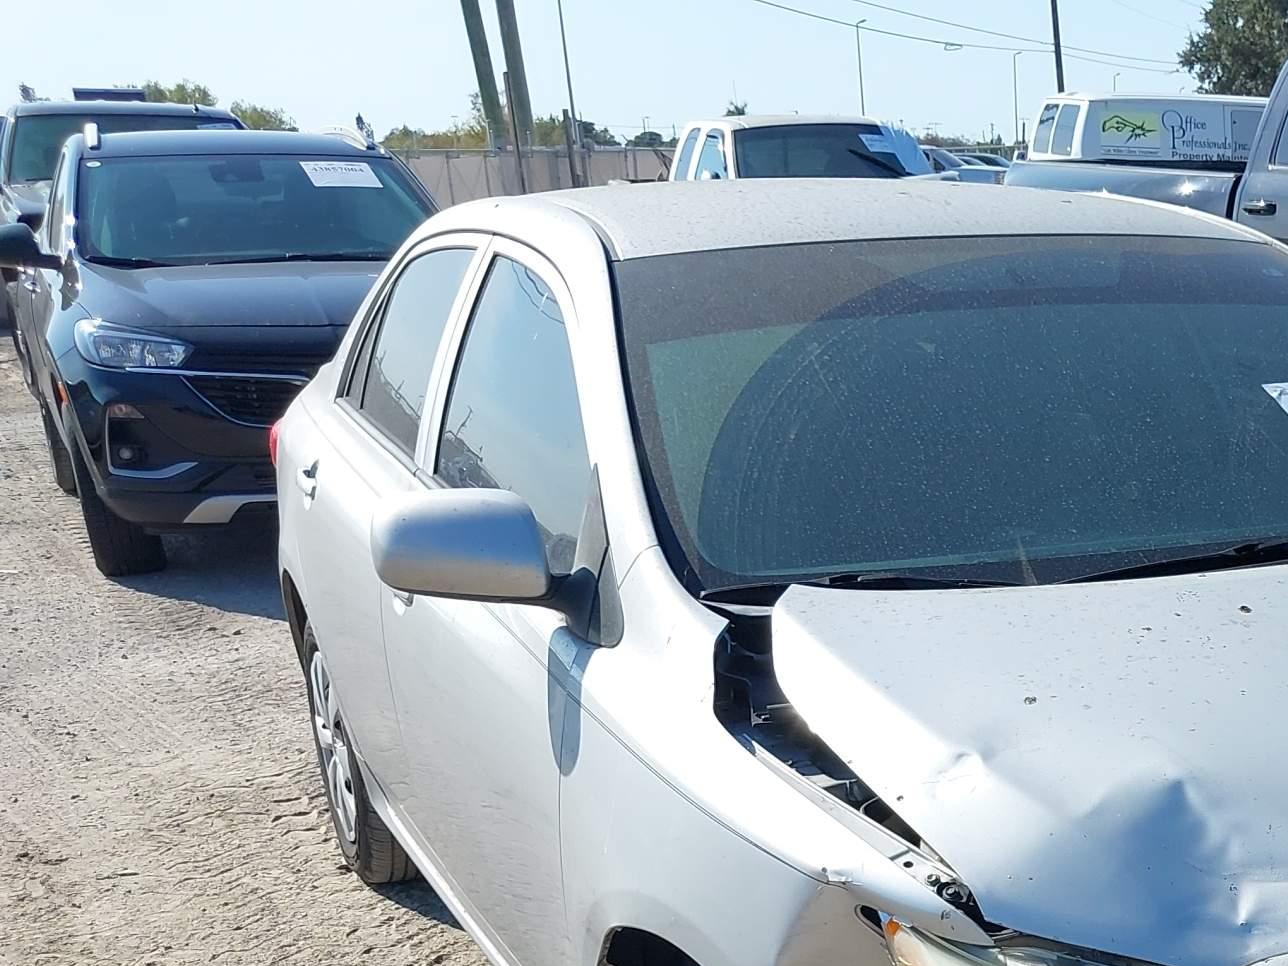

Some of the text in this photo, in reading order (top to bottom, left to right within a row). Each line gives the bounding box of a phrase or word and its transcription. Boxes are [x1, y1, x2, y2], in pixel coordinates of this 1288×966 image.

[1161, 109, 1207, 132] Office
[1171, 126, 1231, 150] Professionals
[1171, 151, 1214, 161] Property
